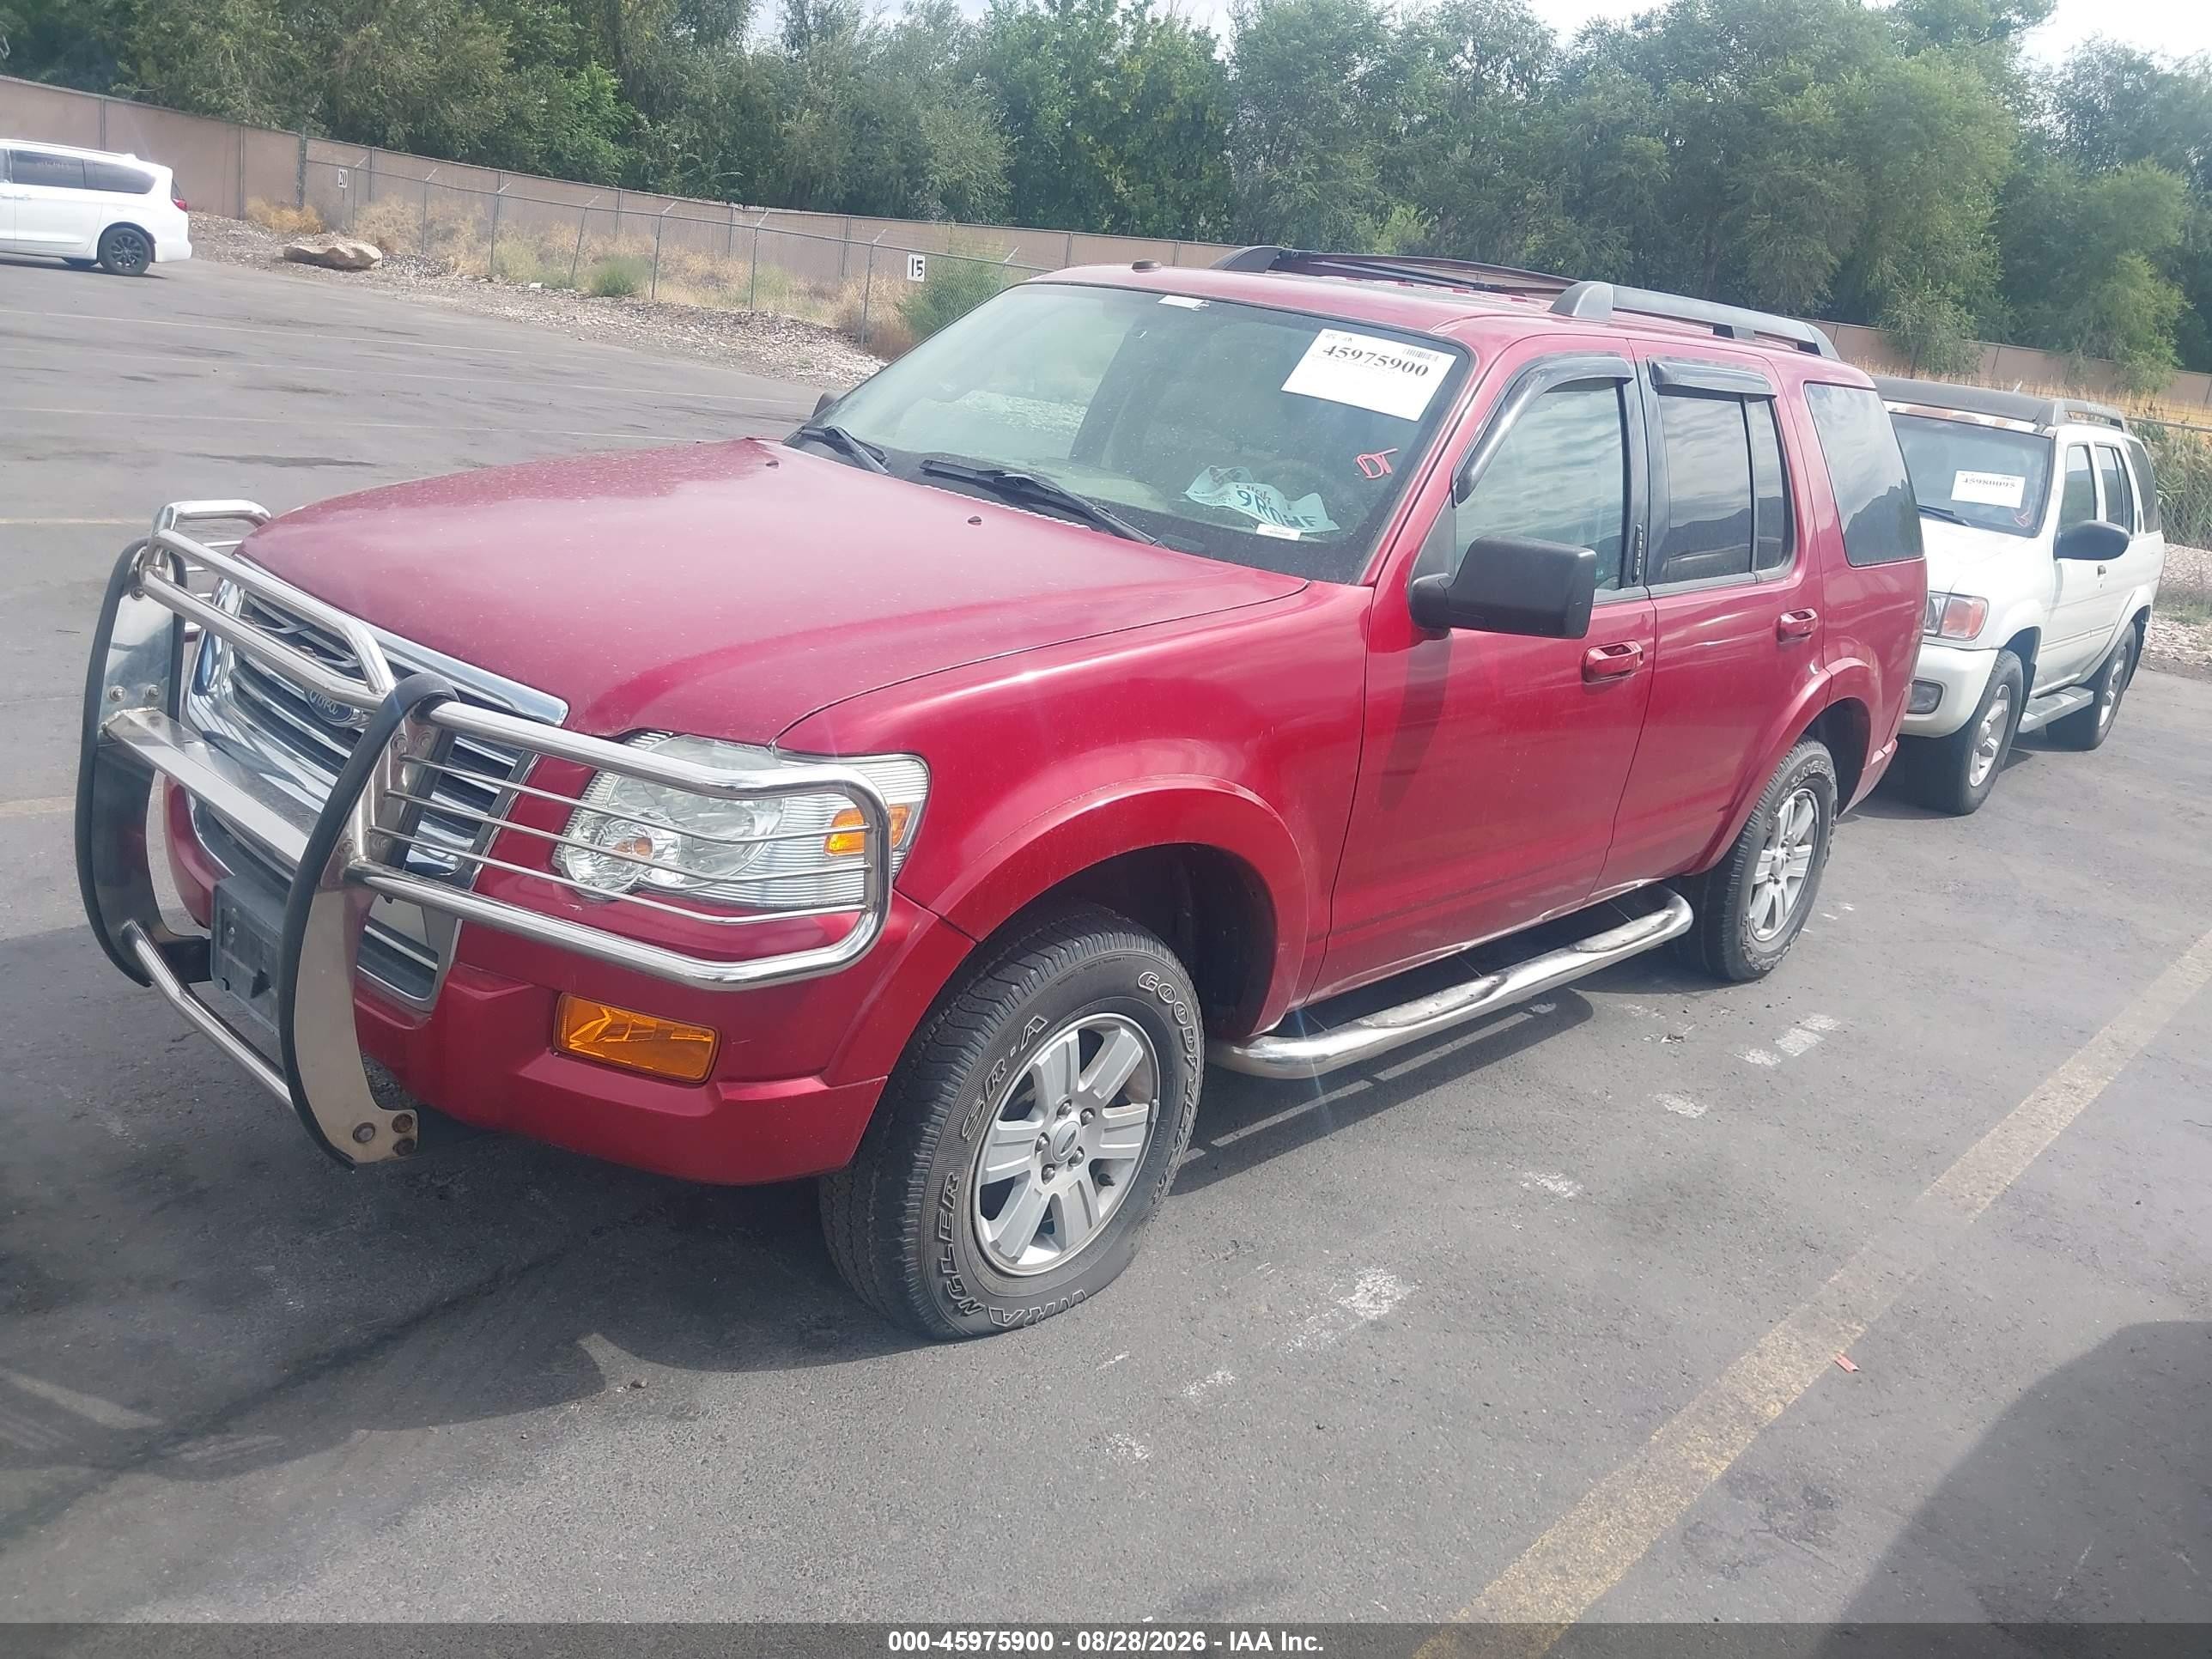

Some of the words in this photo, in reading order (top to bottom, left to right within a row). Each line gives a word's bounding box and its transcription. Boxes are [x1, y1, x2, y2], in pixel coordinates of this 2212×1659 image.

[338, 171, 347, 186] 20
[911, 258, 924, 277] 15
[1322, 345, 1429, 377] 45975900
